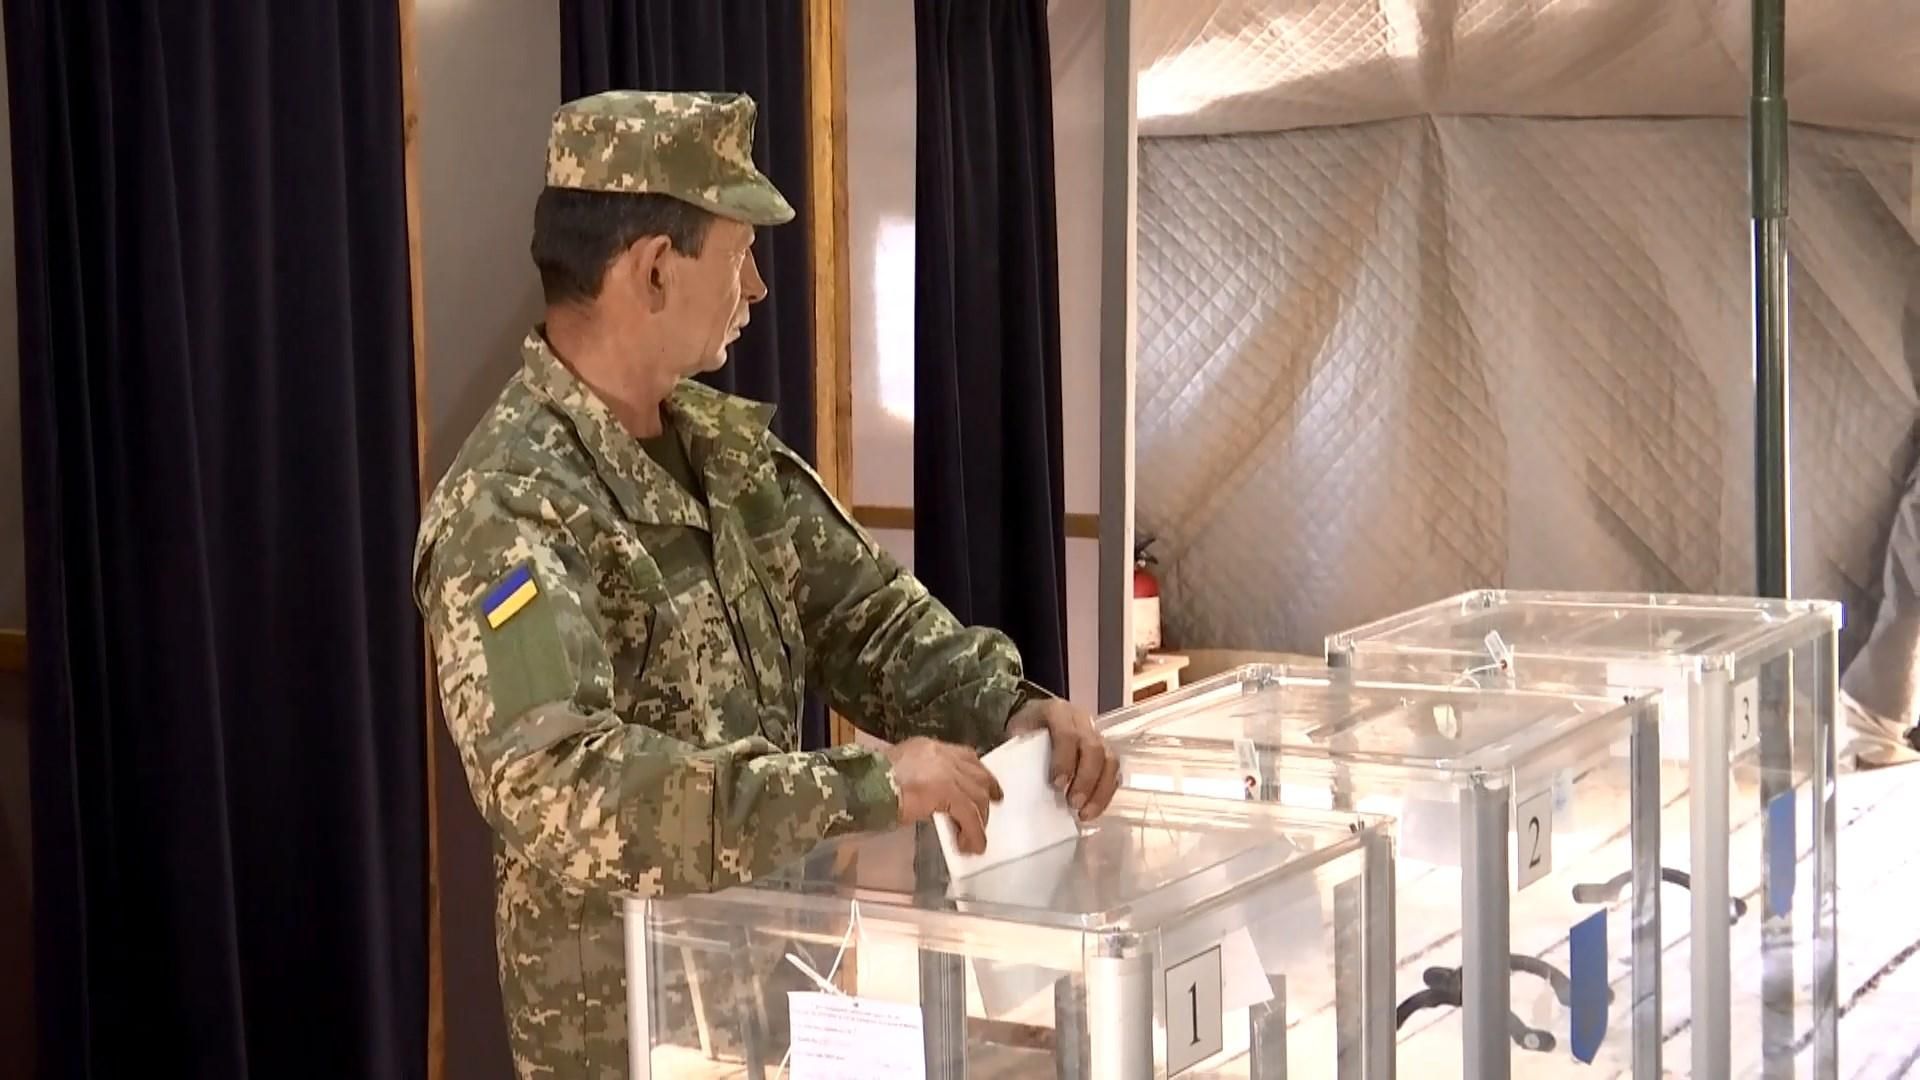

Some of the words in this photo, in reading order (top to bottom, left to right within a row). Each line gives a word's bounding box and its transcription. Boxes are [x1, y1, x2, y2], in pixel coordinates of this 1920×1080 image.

[1741, 695, 1751, 740] 3
[1527, 815, 1542, 870] 2
[1187, 980, 1202, 1047] 1
